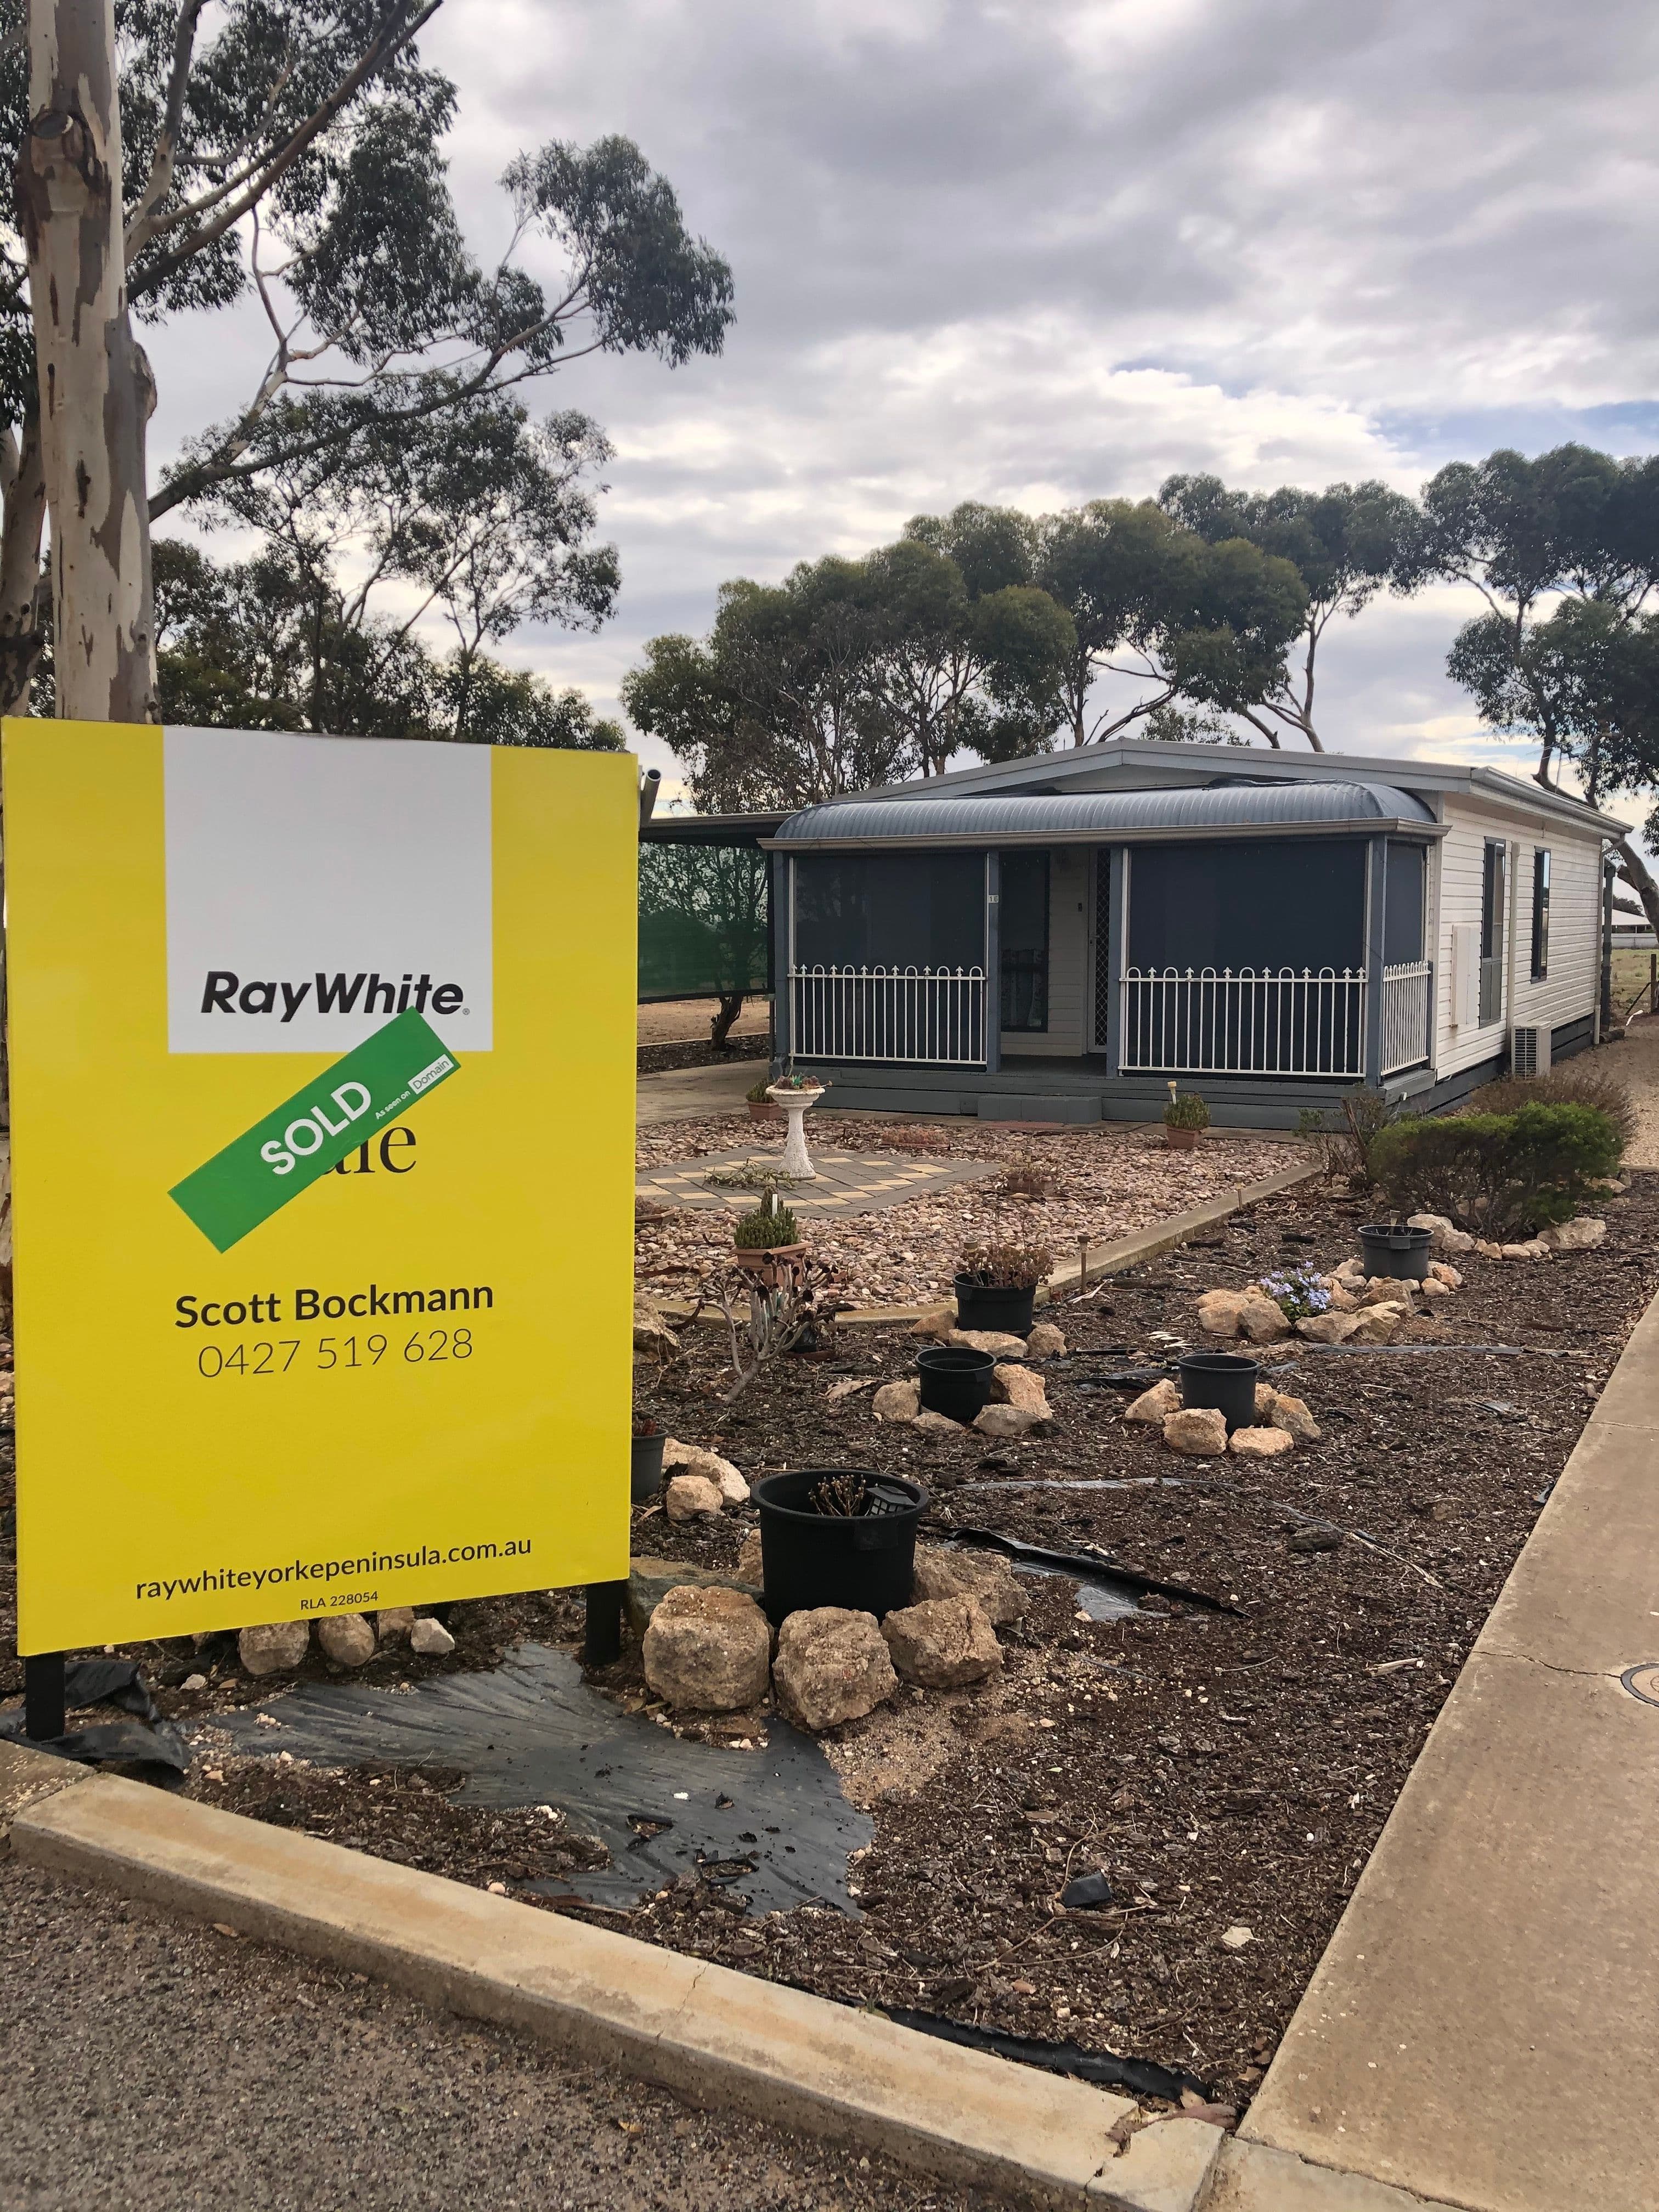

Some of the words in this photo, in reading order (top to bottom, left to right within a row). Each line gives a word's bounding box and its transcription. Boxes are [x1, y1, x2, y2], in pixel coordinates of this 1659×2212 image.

[375, 1110, 386, 1120] As
[385, 1097, 402, 1112] seen
[400, 1090, 411, 1099] on
[413, 1060, 449, 1090] Domain
[260, 1081, 371, 1175] SOLD
[174, 1293, 281, 1328] Scott
[295, 1284, 493, 1321] Bockmann
[199, 1340, 301, 1378] 0427
[317, 1334, 387, 1369] 519
[404, 1328, 472, 1363] 628
[136, 1538, 532, 1600] raywhiteyorkepeninsula.com.au
[300, 1596, 326, 1611] RLA
[330, 1590, 379, 1607] 228054
